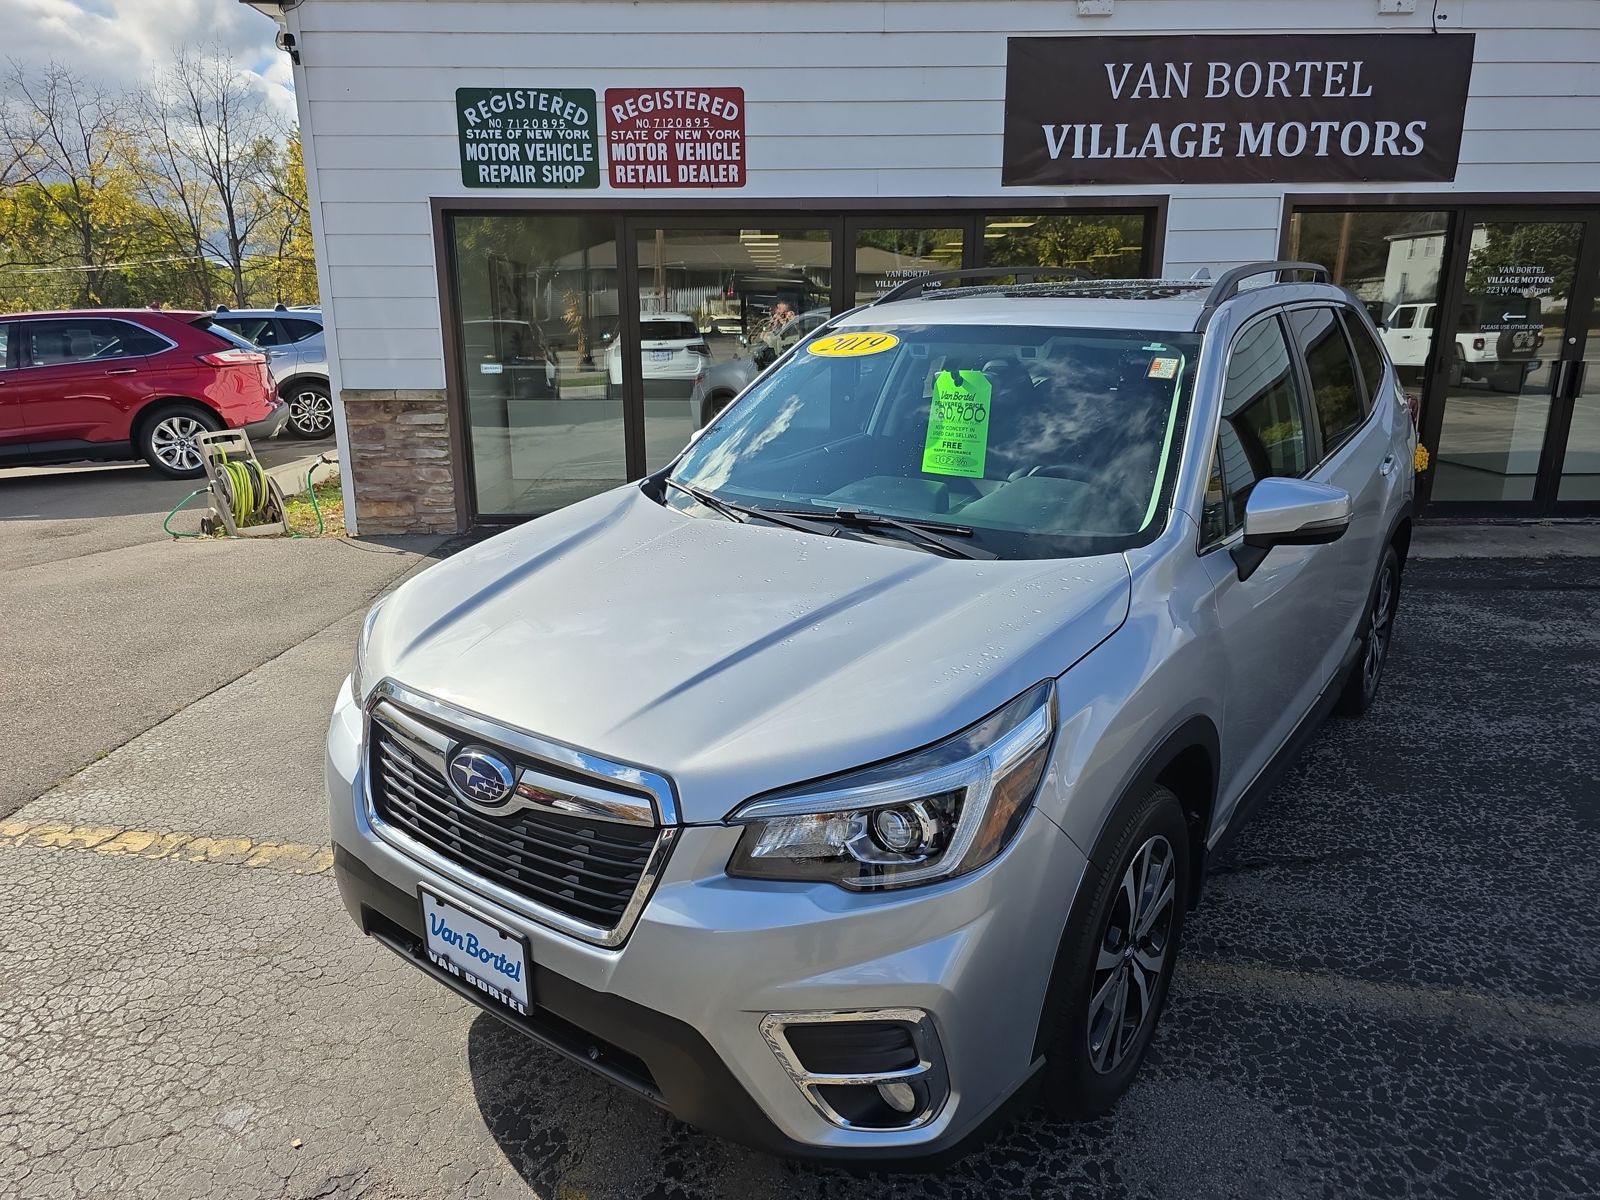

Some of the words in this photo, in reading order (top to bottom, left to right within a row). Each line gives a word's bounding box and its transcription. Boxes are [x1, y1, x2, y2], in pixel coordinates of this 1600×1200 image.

[1105, 62, 1193, 99] VAN
[1205, 60, 1374, 99] BORTEL
[463, 89, 590, 127] REGISTERED
[611, 89, 740, 124] REGISTERED
[488, 118, 505, 130] NO.
[506, 118, 567, 130] 7120895
[635, 118, 652, 130] NO.
[652, 117, 711, 130] 7120895
[465, 128, 503, 140] STATE
[507, 128, 523, 140] OF
[526, 129, 553, 140] NEW
[557, 129, 590, 140] YORK
[610, 129, 649, 141] STATE
[654, 129, 669, 141] OF
[675, 128, 702, 141] NEW
[706, 128, 741, 141] YORK
[1042, 122, 1226, 159] VILLAGE
[1236, 120, 1428, 158] MOTORS
[465, 143, 521, 161] MOTOR
[524, 143, 593, 162] VEHICLE
[611, 142, 668, 161] MOTOR
[675, 142, 741, 161] VEHICLE
[478, 164, 537, 183] REPAIR
[542, 165, 586, 183] SHOP
[615, 164, 671, 183] RETAIL
[678, 164, 739, 182] DEALER
[885, 270, 901, 278] VAN
[1498, 266, 1515, 274] VAN
[1516, 266, 1546, 274] BORTEL
[1487, 276, 1520, 284] VILLAGE
[1486, 286, 1500, 294] 223
[1501, 286, 1510, 294] W
[1510, 286, 1528, 294] Main
[1529, 286, 1551, 294] Street
[817, 336, 888, 351] 2019
[945, 425, 968, 433] CONCEPT
[955, 431, 977, 439] SELLING
[942, 441, 963, 449] FREE
[430, 912, 464, 951] Van
[465, 932, 522, 983] Bortel
[428, 950, 460, 977] VAN
[465, 971, 527, 1017] BORTEL
